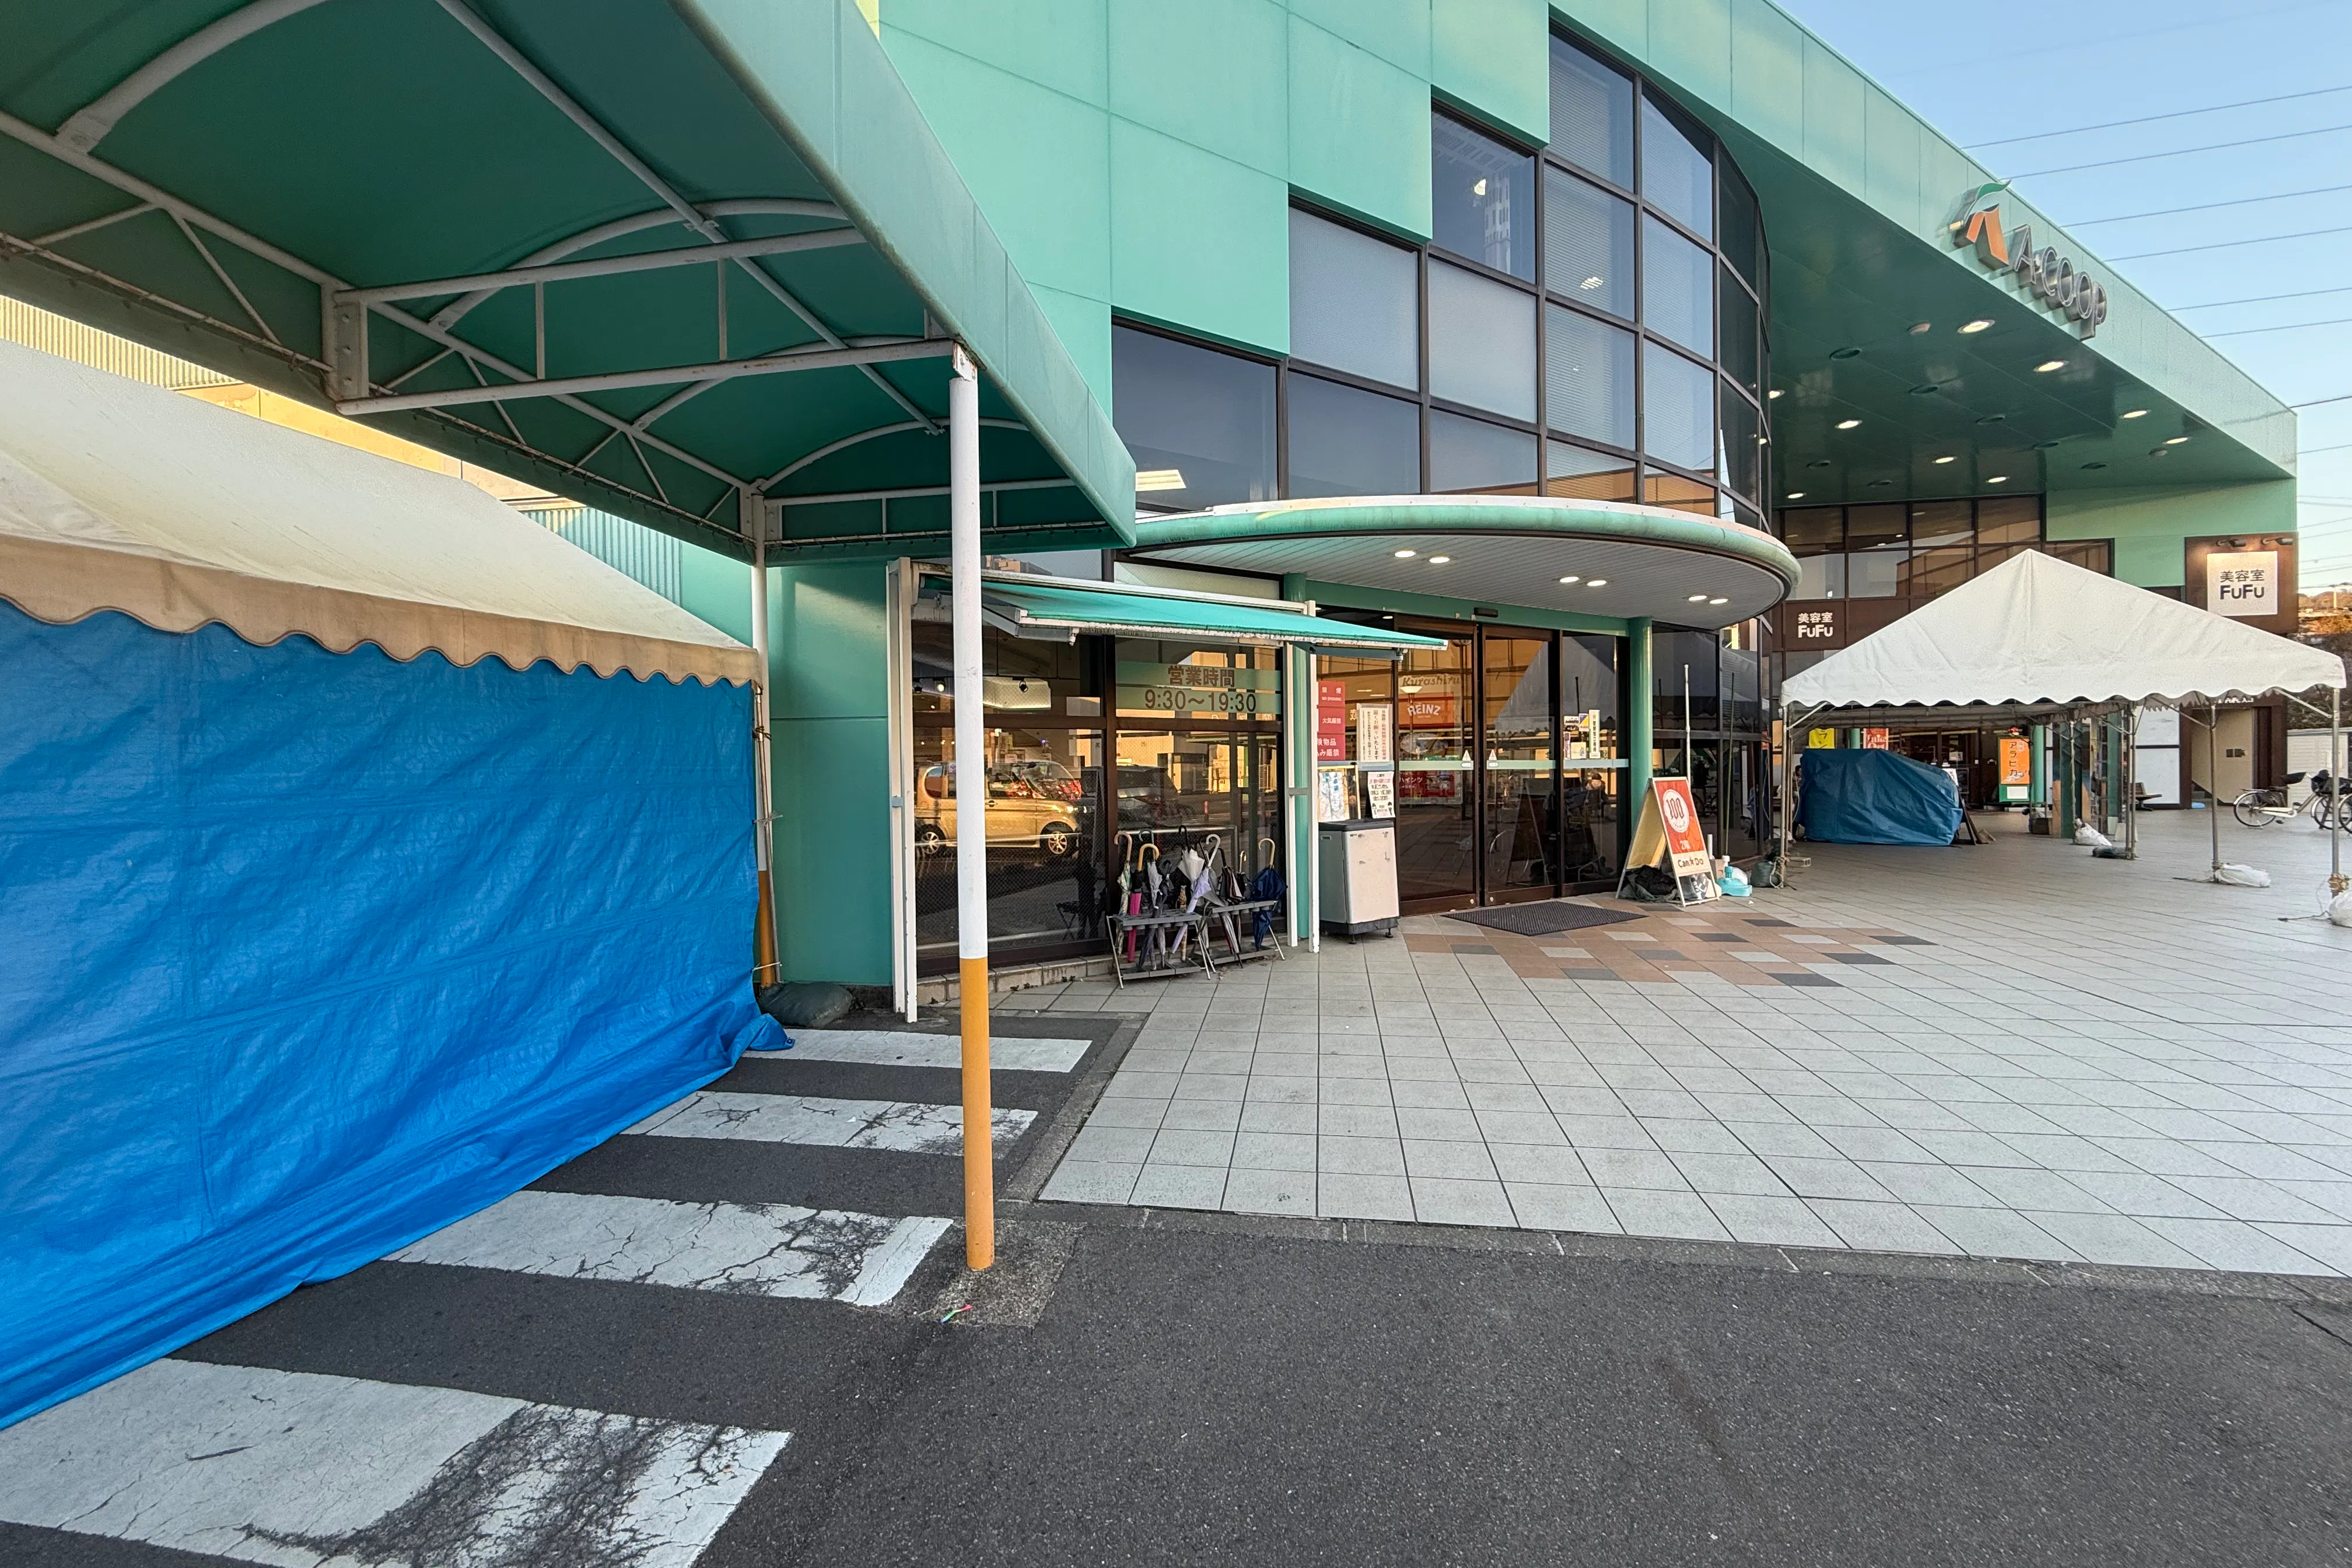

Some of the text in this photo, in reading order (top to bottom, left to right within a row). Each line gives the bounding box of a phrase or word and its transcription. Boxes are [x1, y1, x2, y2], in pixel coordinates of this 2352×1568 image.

[2220, 569, 2265, 583] 美容室
[1798, 611, 1833, 624] 美容室
[1168, 665, 1235, 688] 営業時間
[1402, 675, 1460, 687] Kurashiru
[1665, 797, 1685, 820] 100
